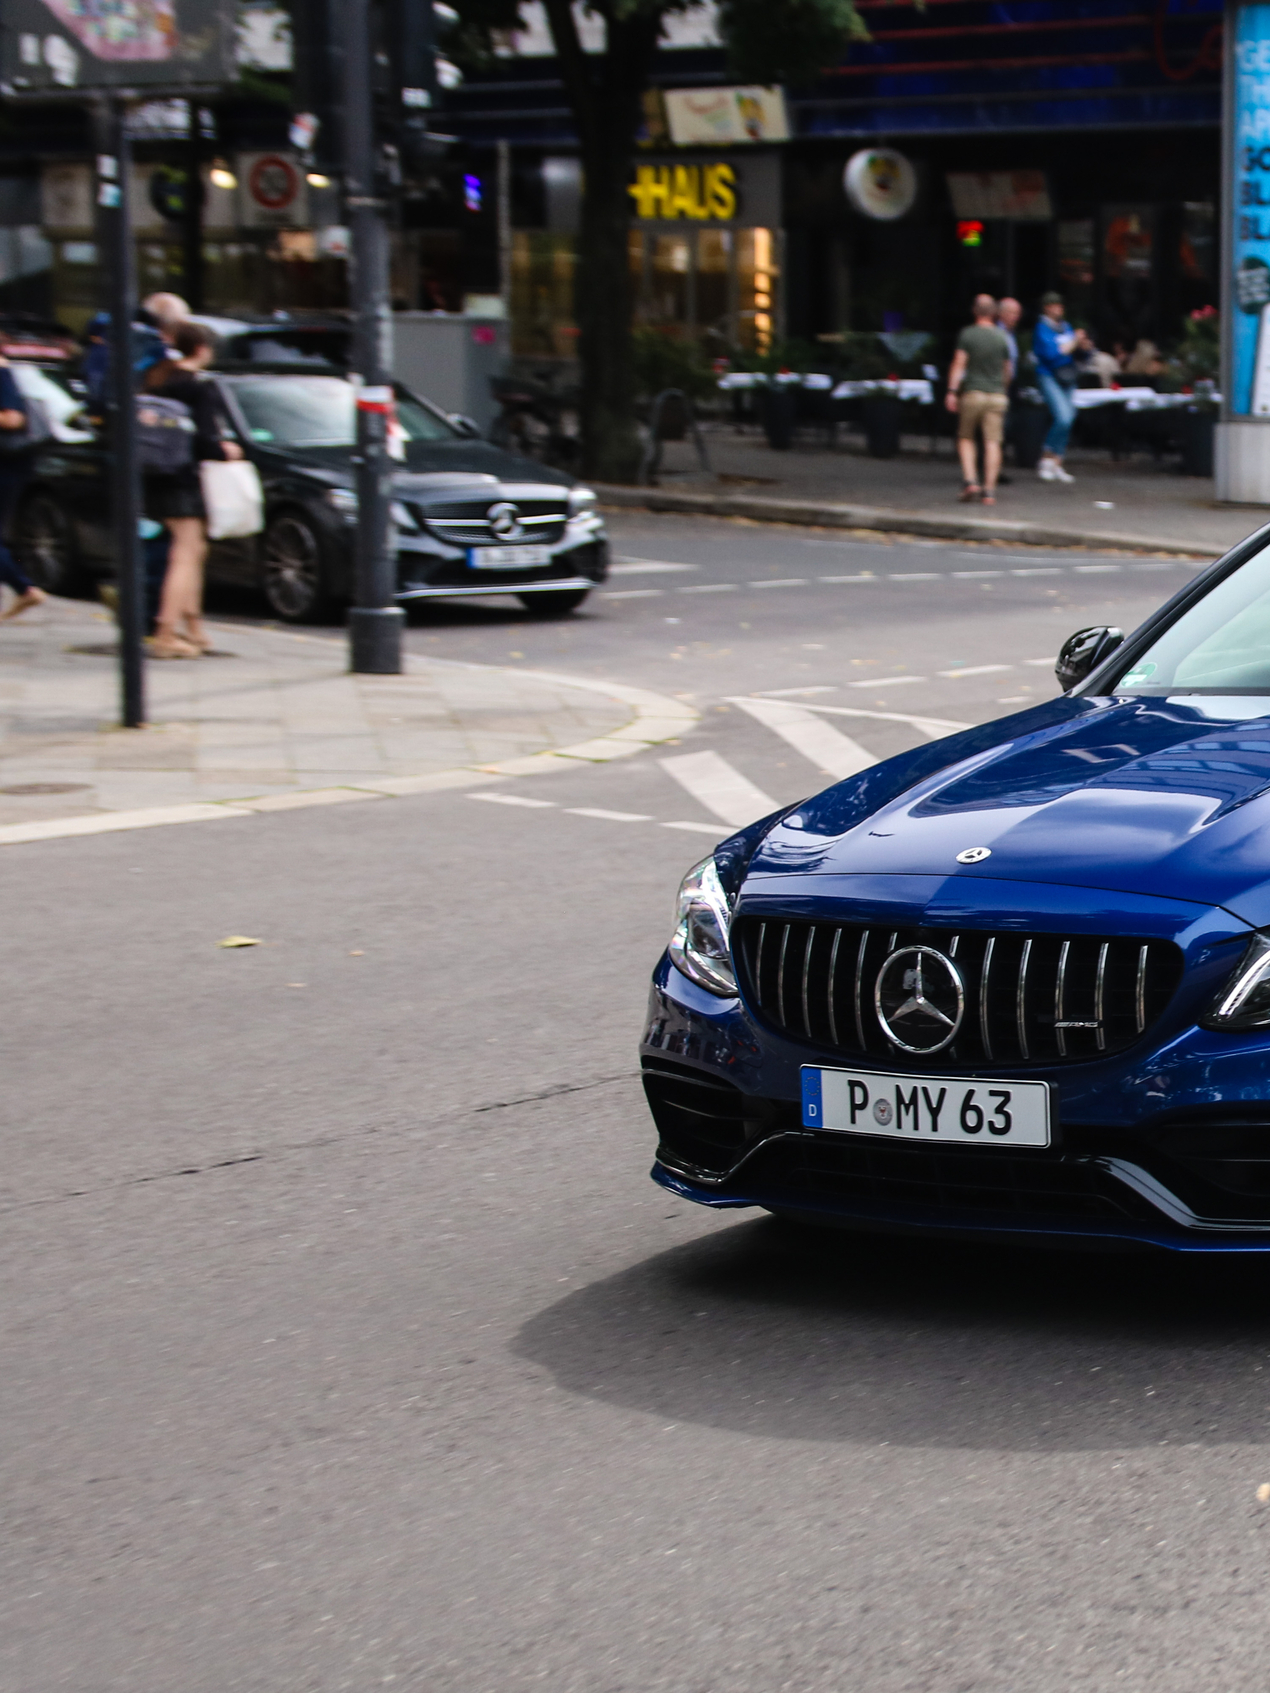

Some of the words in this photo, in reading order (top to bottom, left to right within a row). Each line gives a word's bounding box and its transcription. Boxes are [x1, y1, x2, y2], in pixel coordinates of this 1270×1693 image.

[808, 1104, 818, 1117] D
[847, 1079, 870, 1125] P
[895, 1083, 948, 1132] MY
[960, 1088, 1013, 1136] 63
